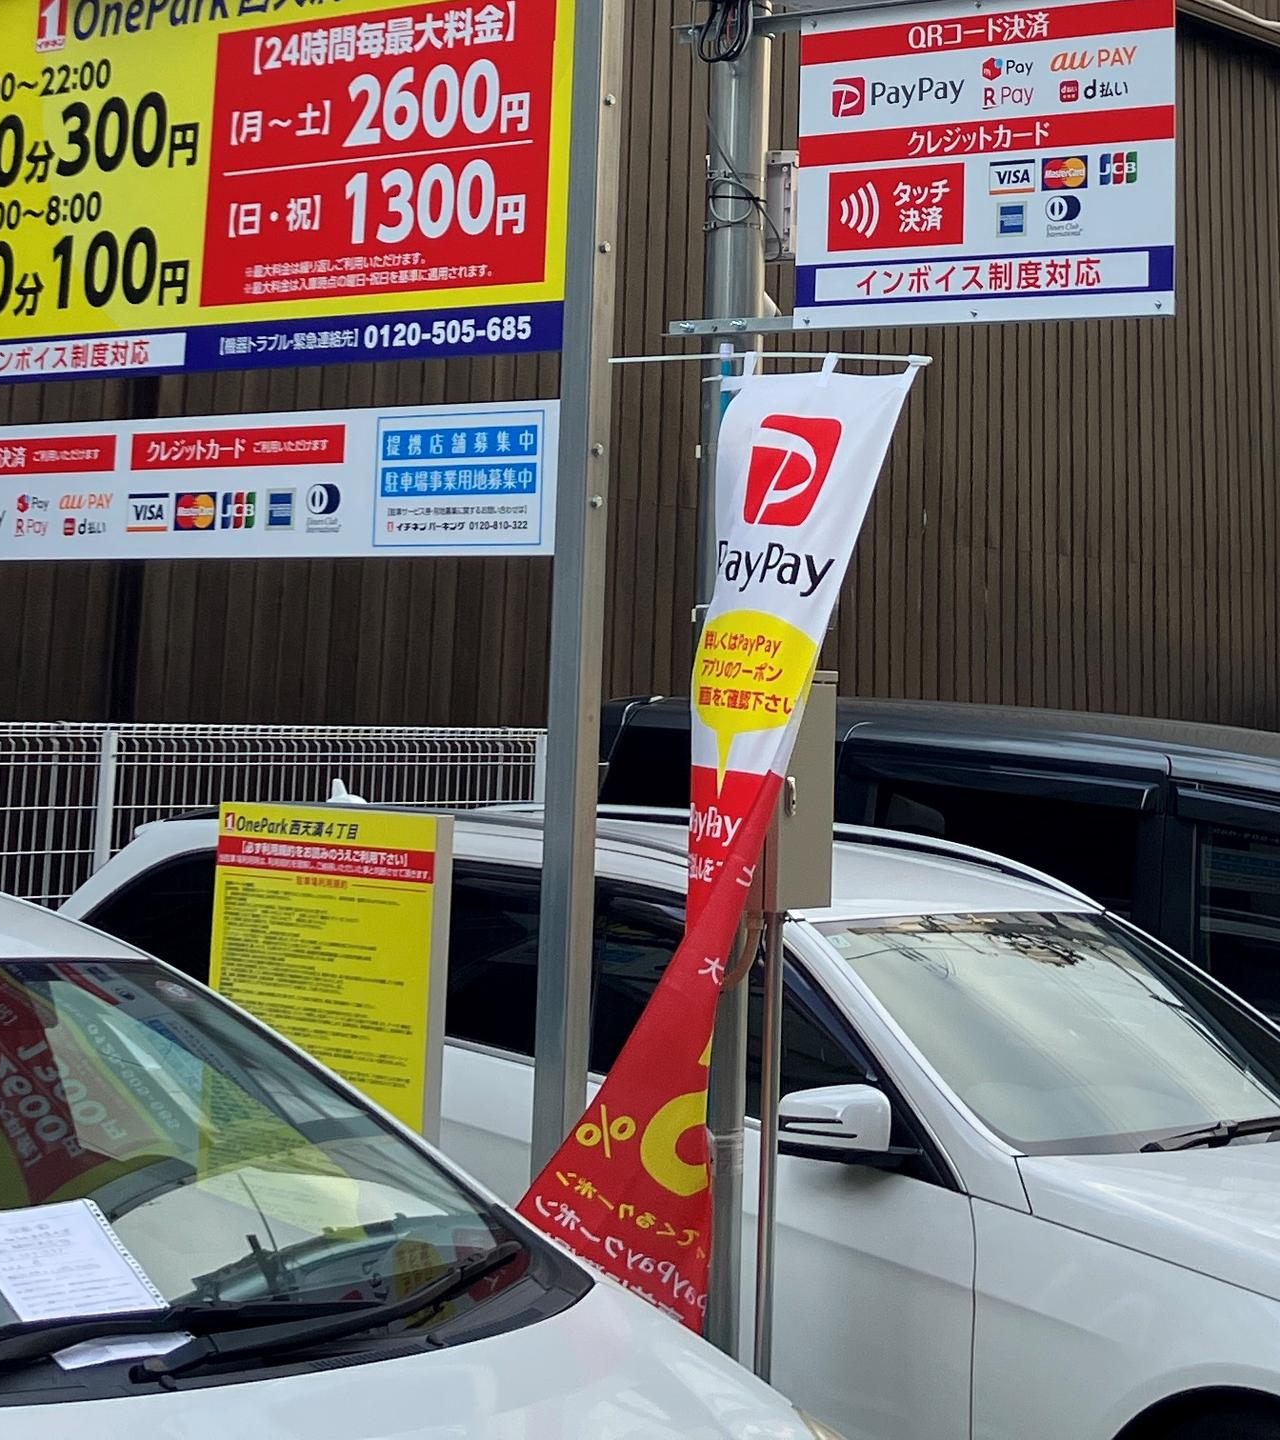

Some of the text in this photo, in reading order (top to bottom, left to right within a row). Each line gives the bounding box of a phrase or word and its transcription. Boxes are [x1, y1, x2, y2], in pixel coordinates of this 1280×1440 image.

[907, 12, 1051, 49] QRコード決済
[1006, 58, 1034, 76] Pay
[1050, 45, 1138, 72] au PAY
[871, 77, 965, 109] PayPay
[1000, 86, 1034, 106] Pay
[1083, 79, 1129, 100] d払い
[341, 58, 531, 147] 2600円
[906, 120, 1051, 156] クレジットカード
[995, 168, 1031, 186] VISA
[1098, 161, 1137, 176] JCB
[344, 158, 527, 244] 1300円
[891, 178, 951, 208] タッチ
[898, 206, 944, 234] 決済
[856, 257, 1101, 297] インボイス制度対応
[363, 315, 532, 350] 0120-505-685
[147, 438, 247, 463] クレジットカード
[386, 430, 534, 457] 提携店舗募集中
[385, 467, 533, 494] 駐車場事業用地募集中
[31, 496, 50, 511] Pay
[88, 493, 113, 509] PAY
[133, 504, 164, 521] VISA
[220, 503, 256, 517] JCB
[26, 519, 49, 536] Pay
[396, 521, 427, 532] イチネン
[468, 520, 529, 531] 0120-810-322
[701, 659, 783, 682] アプリのクーポン
[236, 816, 288, 835] OnePark
